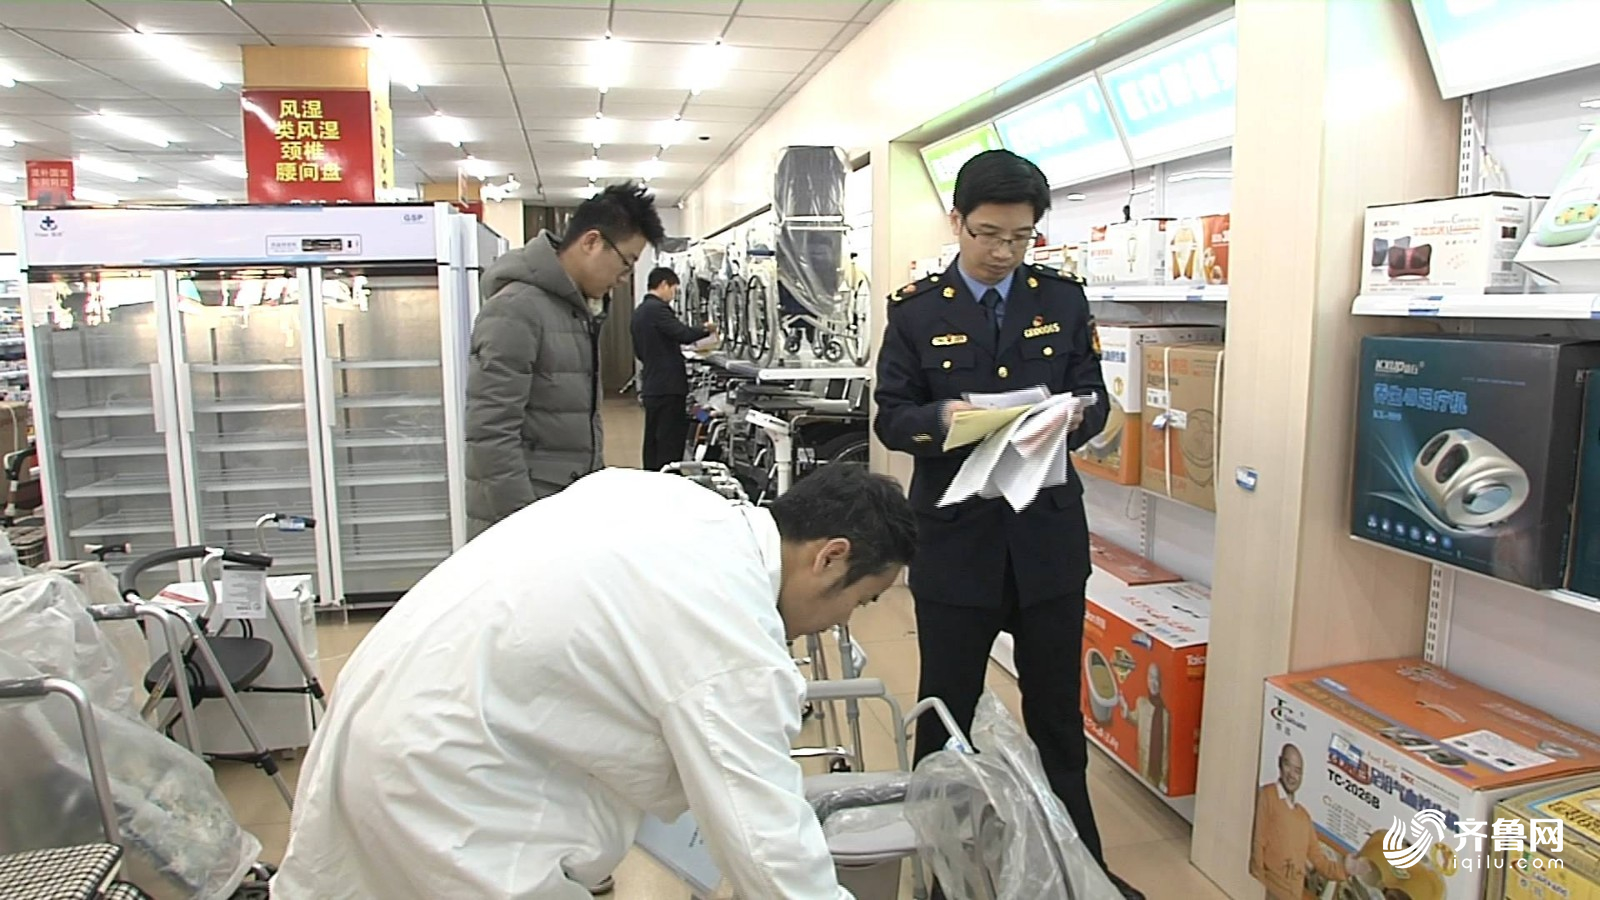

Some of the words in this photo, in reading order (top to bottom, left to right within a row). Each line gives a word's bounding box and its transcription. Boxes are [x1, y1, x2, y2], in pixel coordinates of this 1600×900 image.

[279, 99, 323, 119] 风湿
[274, 120, 340, 140] 类风湿
[280, 141, 325, 161] 颈椎
[275, 162, 342, 182] 腰间盘
[403, 214, 424, 223] GSP
